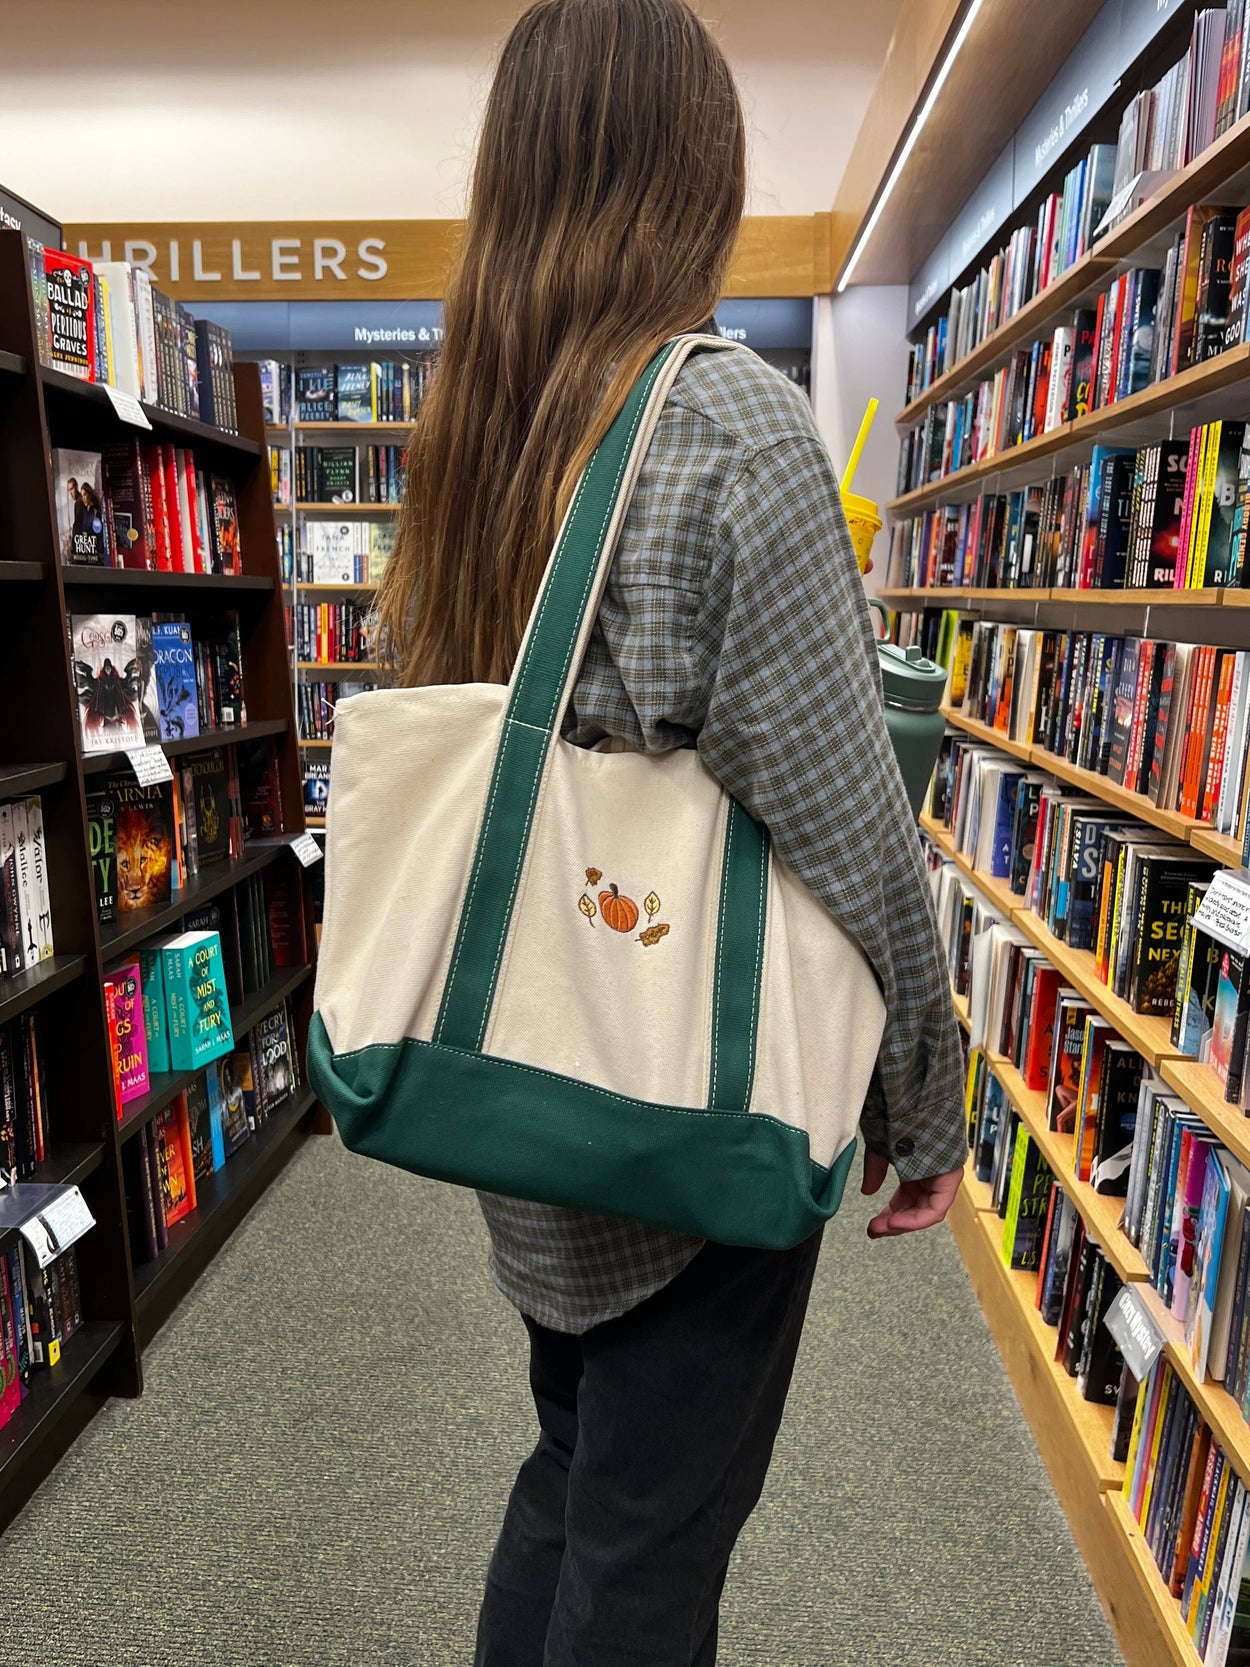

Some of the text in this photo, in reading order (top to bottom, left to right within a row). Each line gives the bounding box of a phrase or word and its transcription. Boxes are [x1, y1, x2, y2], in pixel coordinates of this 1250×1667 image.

[62, 239, 389, 282] HRILLERS
[47, 281, 88, 309] BALLAD
[51, 312, 87, 341] PERILOUS
[354, 327, 416, 344] Mysteries
[418, 327, 430, 341] &
[53, 334, 87, 356] GRAVES
[74, 534, 97, 545] GREAT
[75, 544, 95, 554] HUNT
[164, 626, 181, 635] KUAN
[305, 772, 331, 780] GREAN
[310, 764, 328, 773] MAR
[1162, 900, 1187, 914] TH
[188, 944, 218, 968] A COURT
[201, 966, 209, 977] OF
[196, 978, 217, 1000] MIST
[203, 999, 215, 1013] AND
[199, 1010, 222, 1034] FURY
[268, 1010, 284, 1029] CRY
[195, 1031, 230, 1055] SARAH MAAS
[127, 1072, 146, 1088] MAAS
[1118, 1291, 1156, 1360] Cozy Mystery
[1204, 1444, 1218, 1495] ARSENIC
[1209, 1456, 1223, 1506] BLACKMAIL
[1198, 1528, 1209, 1571] BIBINGKA
